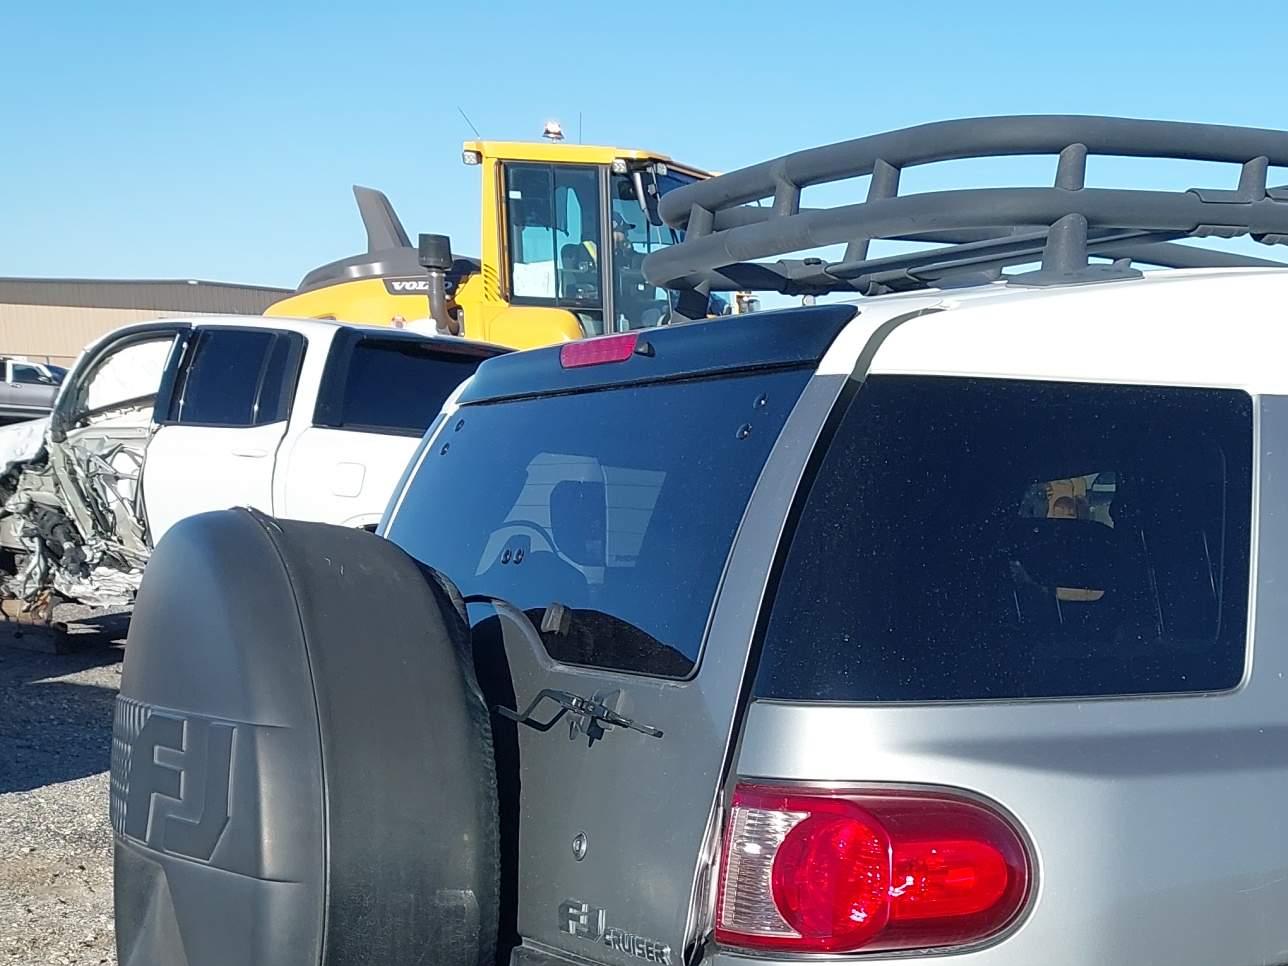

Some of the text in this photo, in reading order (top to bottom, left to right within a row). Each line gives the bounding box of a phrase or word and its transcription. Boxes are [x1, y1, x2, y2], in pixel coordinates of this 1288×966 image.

[392, 281, 453, 290] VOLO
[124, 712, 238, 864] FJ
[559, 899, 673, 966] FJ CRUISER
